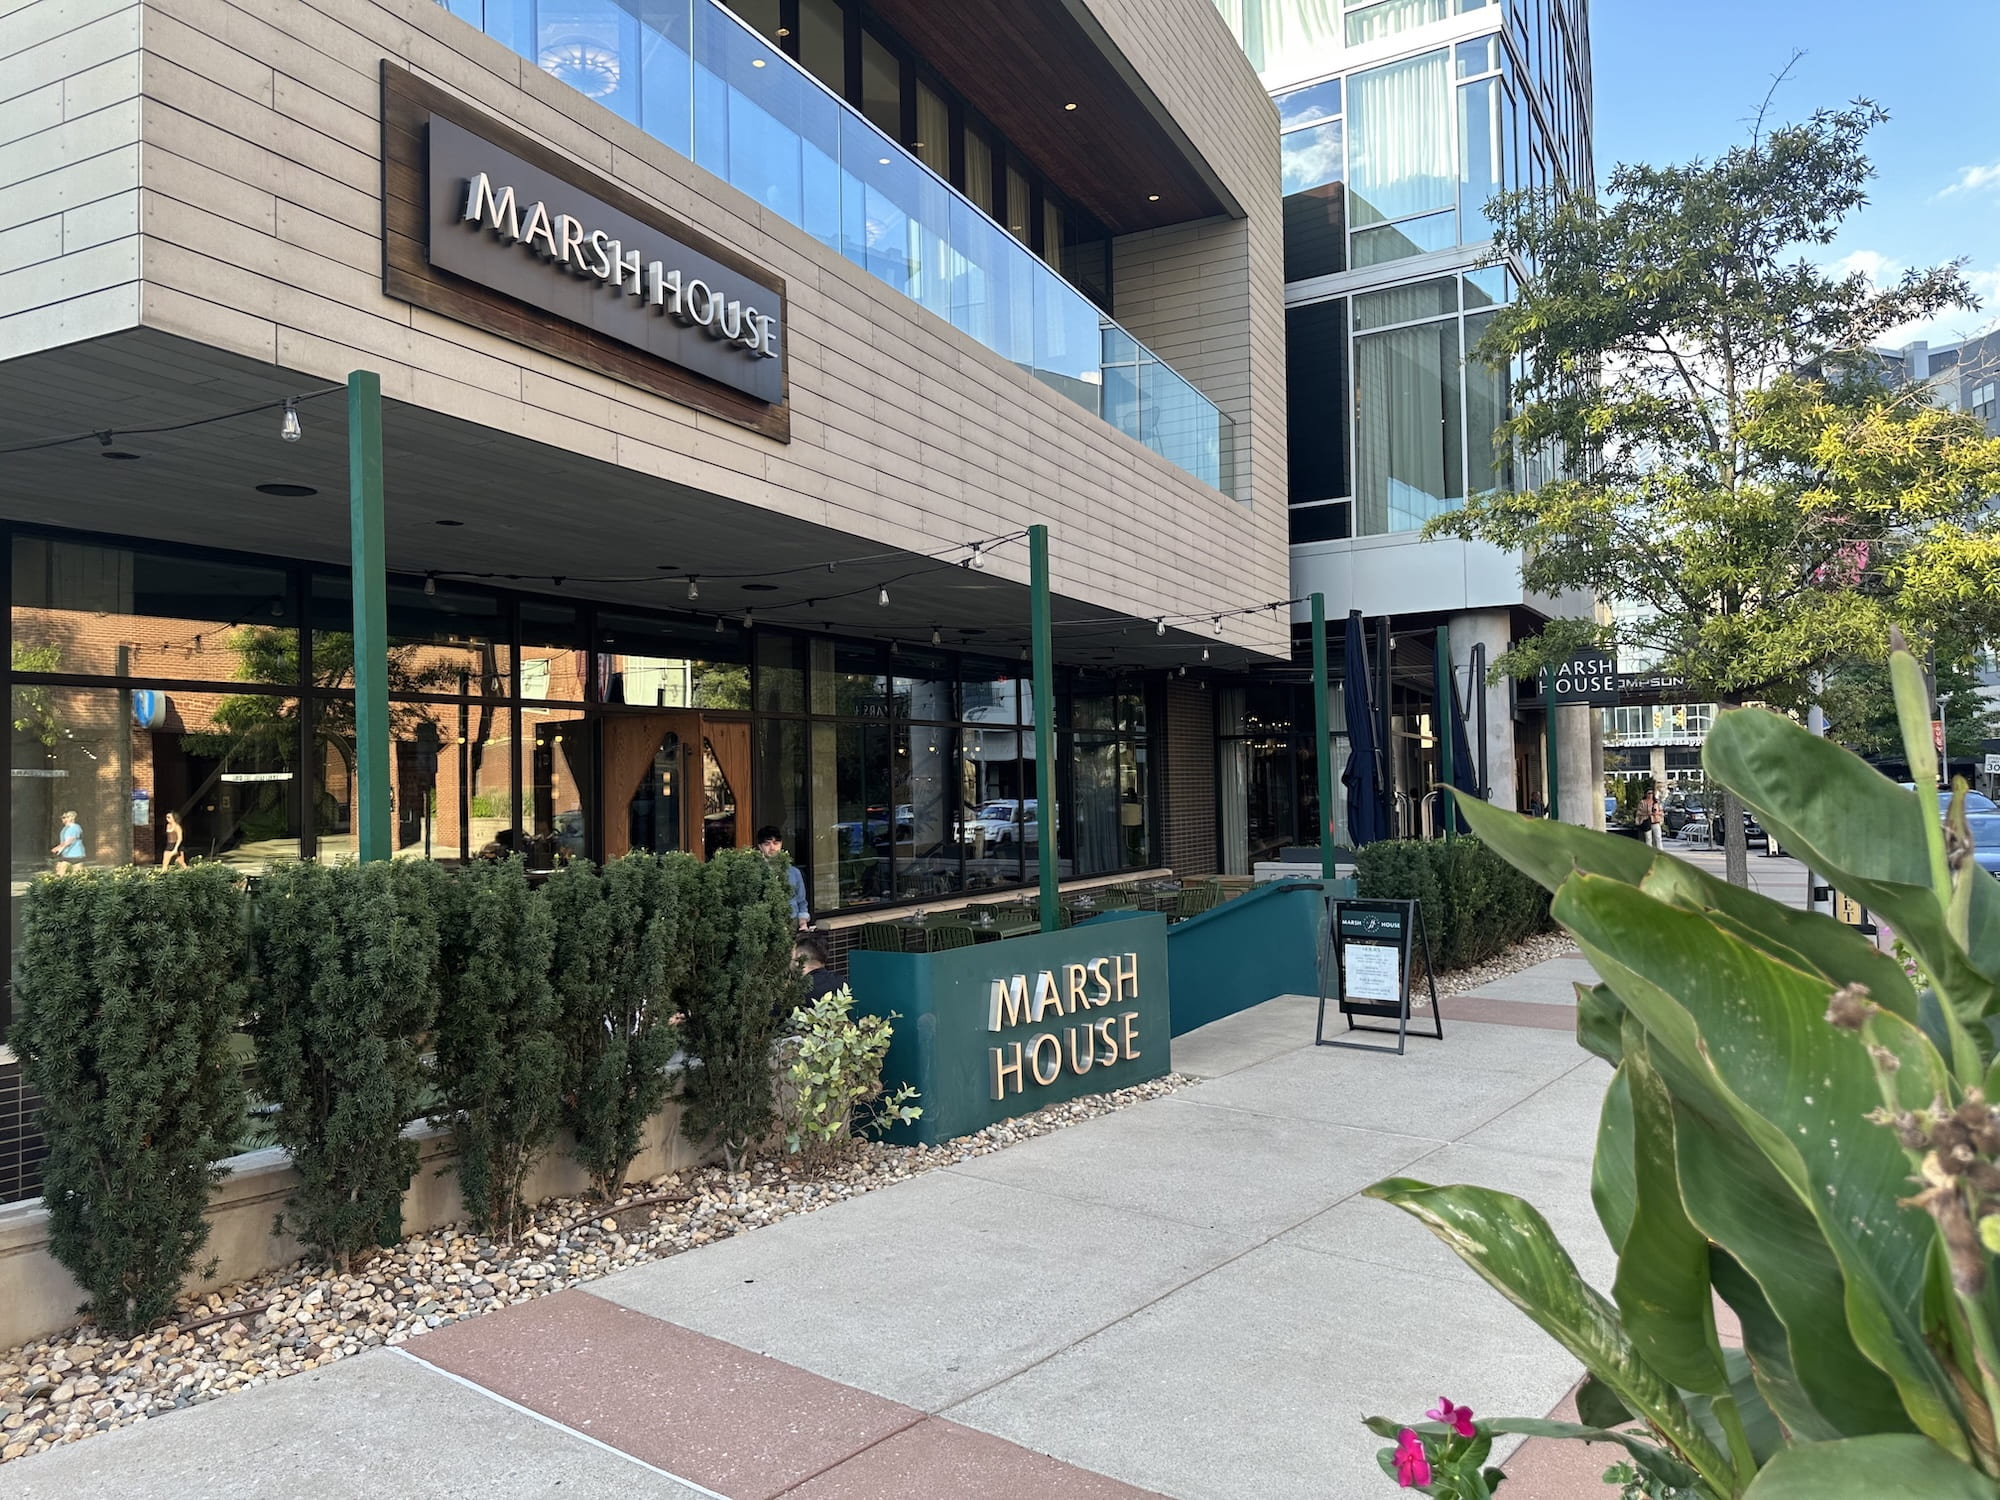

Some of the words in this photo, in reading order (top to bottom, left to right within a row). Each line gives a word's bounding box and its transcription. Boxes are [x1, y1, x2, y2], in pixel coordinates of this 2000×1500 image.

[464, 171, 641, 296] MARSH
[648, 260, 778, 359] HOUSE
[1539, 676, 1613, 694] HOUSE
[1986, 764, 2000, 772] 30
[1843, 895, 1855, 922] ET
[988, 953, 1138, 1032] MARSH
[988, 1012, 1141, 1101] HOUSE
